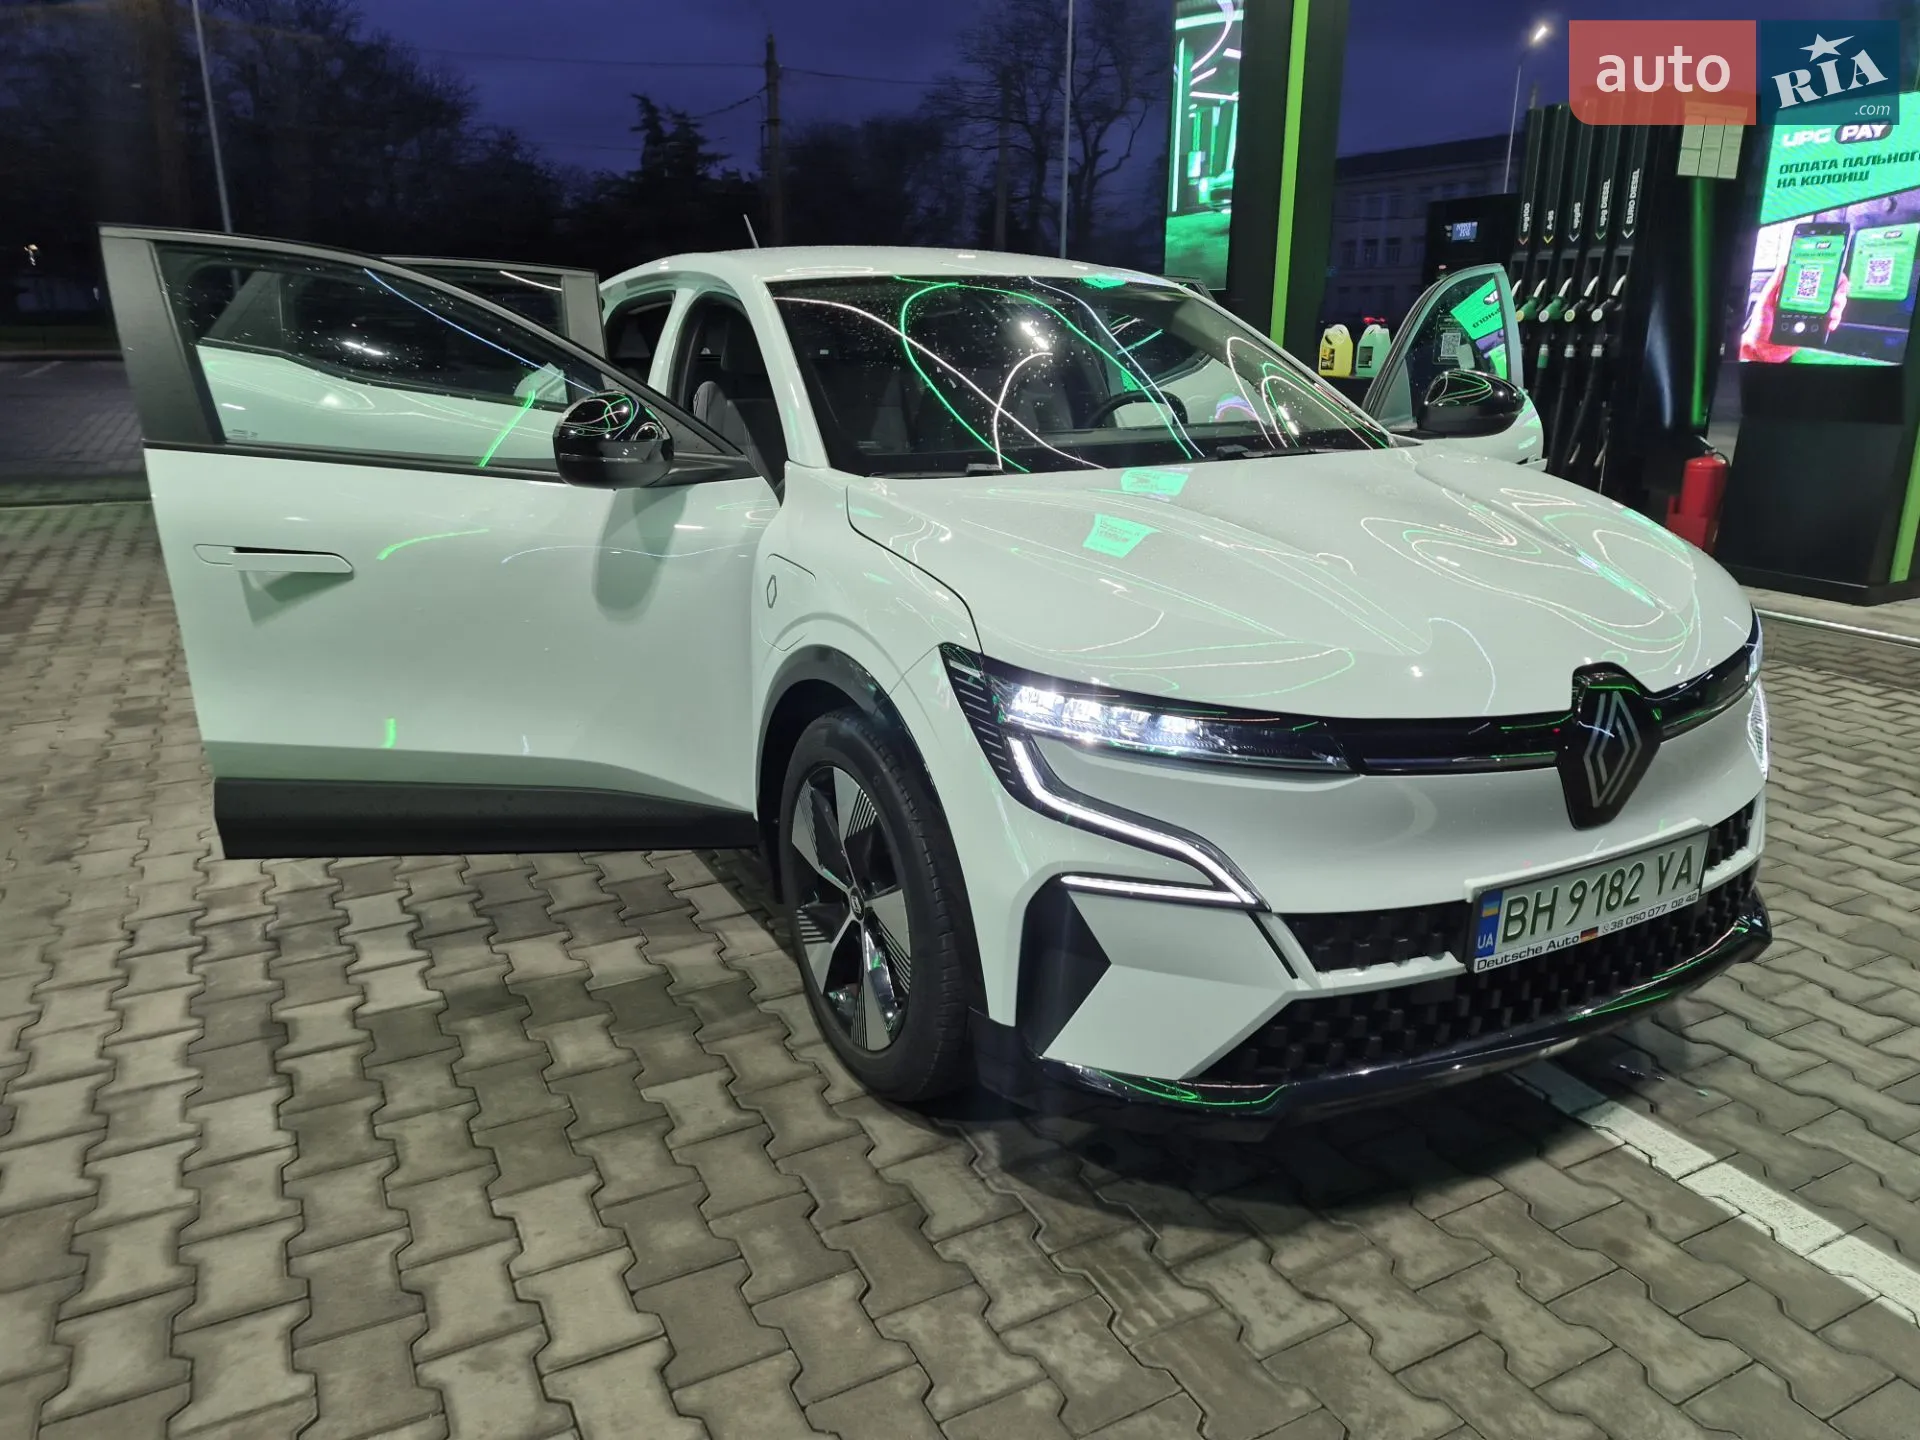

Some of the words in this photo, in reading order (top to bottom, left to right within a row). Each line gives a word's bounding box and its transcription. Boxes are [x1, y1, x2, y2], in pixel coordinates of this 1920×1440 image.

[1782, 127, 1832, 147] UPG
[1840, 121, 1890, 142] PAY
[1779, 159, 1839, 175] ОПЛАТА
[1842, 150, 1920, 168] ПАЛЬНОГ
[1600, 178, 1611, 209] DIESEL
[1629, 167, 1640, 199] DIESEL
[1776, 177, 1797, 188] НА
[1625, 199, 1636, 224] EURO
[1502, 886, 1559, 943] BH
[1565, 862, 1646, 926] 9182
[1657, 845, 1693, 896] YA
[1625, 912, 1646, 926] 050
[1647, 904, 1667, 918] 077
[1671, 898, 1684, 909] 02
[1477, 932, 1494, 949] UA
[1477, 945, 1543, 971] Deutsche
[1546, 935, 1580, 952] Auto
